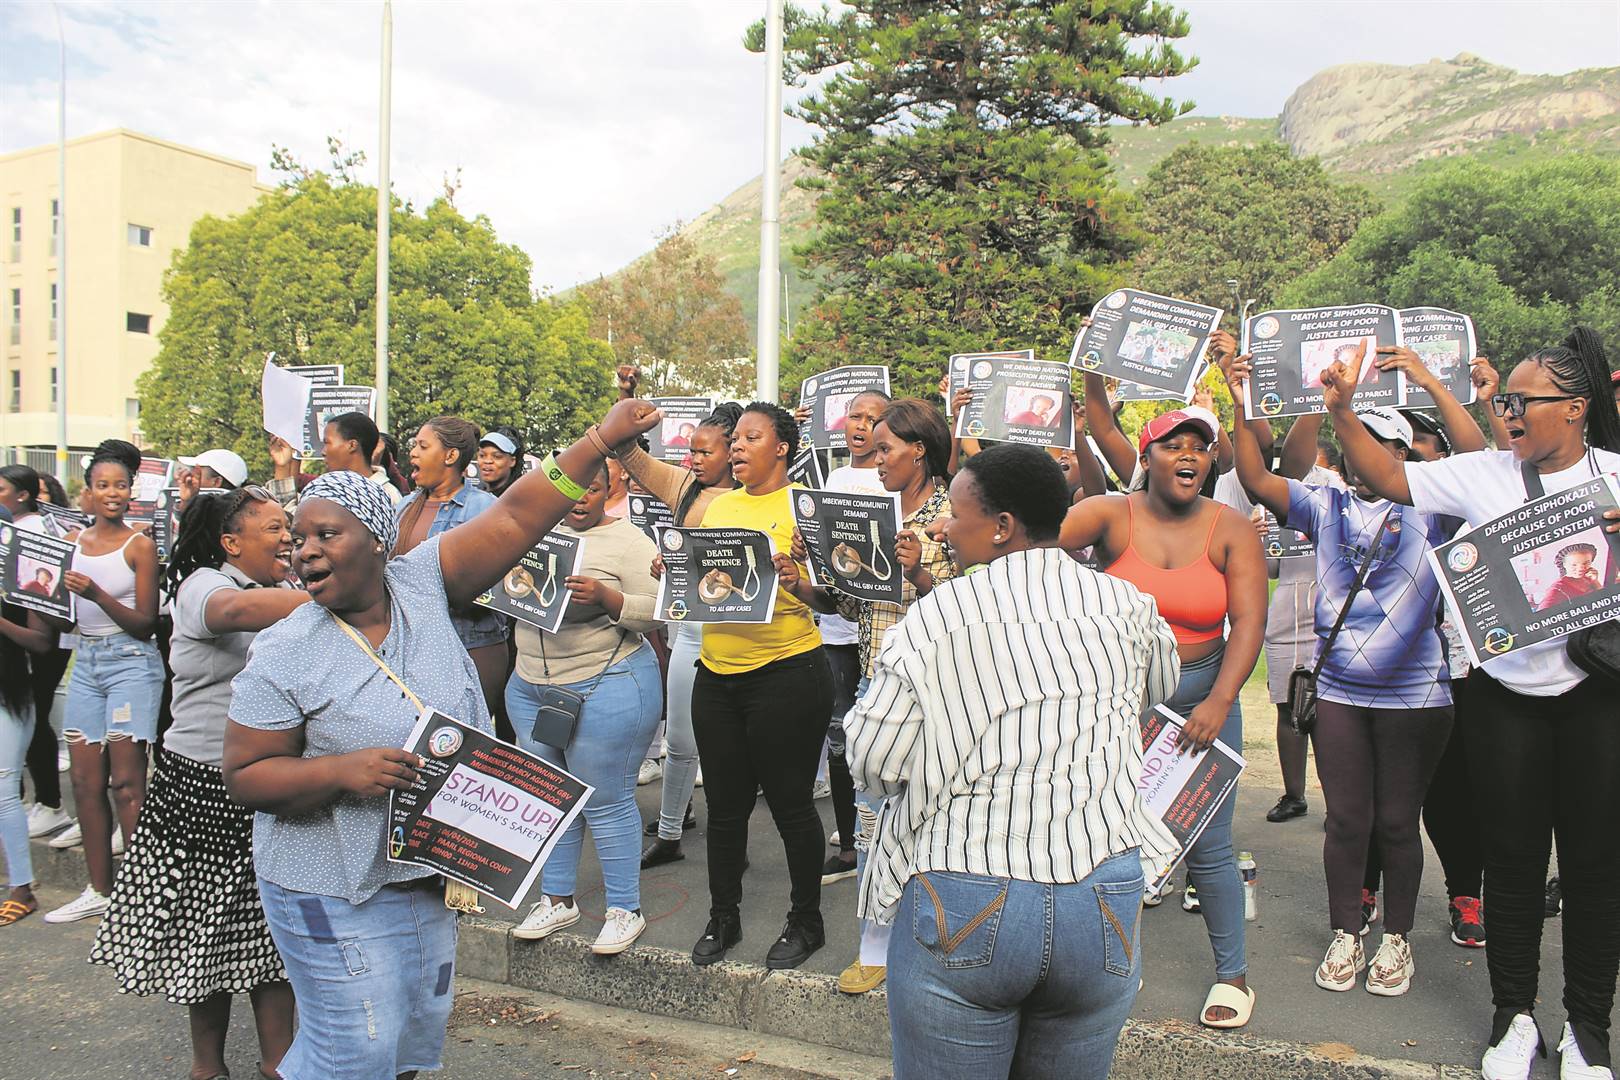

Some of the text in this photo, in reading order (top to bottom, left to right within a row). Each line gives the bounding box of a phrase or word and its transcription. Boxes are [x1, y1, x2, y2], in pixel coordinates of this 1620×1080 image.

[1130, 306, 1208, 329] DEMANDING JUSTICE TO
[1170, 305, 1213, 320] COMMUNITY
[1291, 312, 1319, 321] DEATH
[1320, 310, 1330, 318] OF
[1333, 308, 1379, 318] SIPHOKAZI
[1301, 317, 1379, 331] BECAUSE OF POOR
[1414, 315, 1464, 324] COMMUNITY
[1140, 319, 1190, 335] ALL GBV CASES
[1422, 324, 1453, 332] JUSTICE
[1305, 328, 1374, 340] JUSTICE SYSTEM
[1423, 334, 1447, 342] CASES
[996, 370, 1038, 379] PROSECUTION
[1014, 364, 1041, 372] DEMAND
[1122, 361, 1144, 371] JUSTICE
[1144, 366, 1162, 375] MUST
[1030, 381, 1056, 389] ANSWER
[1365, 390, 1392, 398] PAROLE
[1353, 401, 1376, 409] CASES
[1008, 427, 1029, 435] ABOUT
[822, 497, 889, 510] MBEKWENI COMMUNITY
[1484, 482, 1601, 537] DEATH OF SIPHOKAZI IS
[843, 510, 868, 518] DEMAND
[836, 521, 858, 531] DEATH
[1501, 500, 1596, 544] BECAUSE OF POOR
[543, 535, 574, 548] MMUNITY
[832, 531, 866, 542] SENTENCE
[1512, 516, 1595, 554] JUSTICE SYSTEM
[535, 543, 550, 551] AND
[706, 549, 733, 557] DEATH
[520, 558, 544, 570] TENCE
[702, 558, 741, 567] SENTENCE
[1525, 622, 1540, 633] NO
[1541, 612, 1570, 627] MORE
[1570, 606, 1591, 617] BAIL
[1592, 598, 1611, 610] AND
[1551, 627, 1564, 636] TO
[1566, 622, 1582, 632] ALL
[1582, 614, 1601, 625] GBV
[523, 760, 565, 784] COMMUNITY
[503, 773, 514, 781] OF
[512, 777, 546, 798] SIPHOKAZI
[507, 763, 530, 779] MARCH
[530, 773, 557, 792] AGAINST
[556, 786, 573, 800] GBV
[1177, 763, 1219, 824] PAARL REGIONAL COURT
[446, 772, 519, 812] STAND
[520, 803, 558, 834] UP!
[436, 790, 546, 842] FOR WOMEN'S SAFETY
[416, 820, 432, 829] DATE
[411, 828, 512, 875] PLACE PAARL REGIONAL COURT
